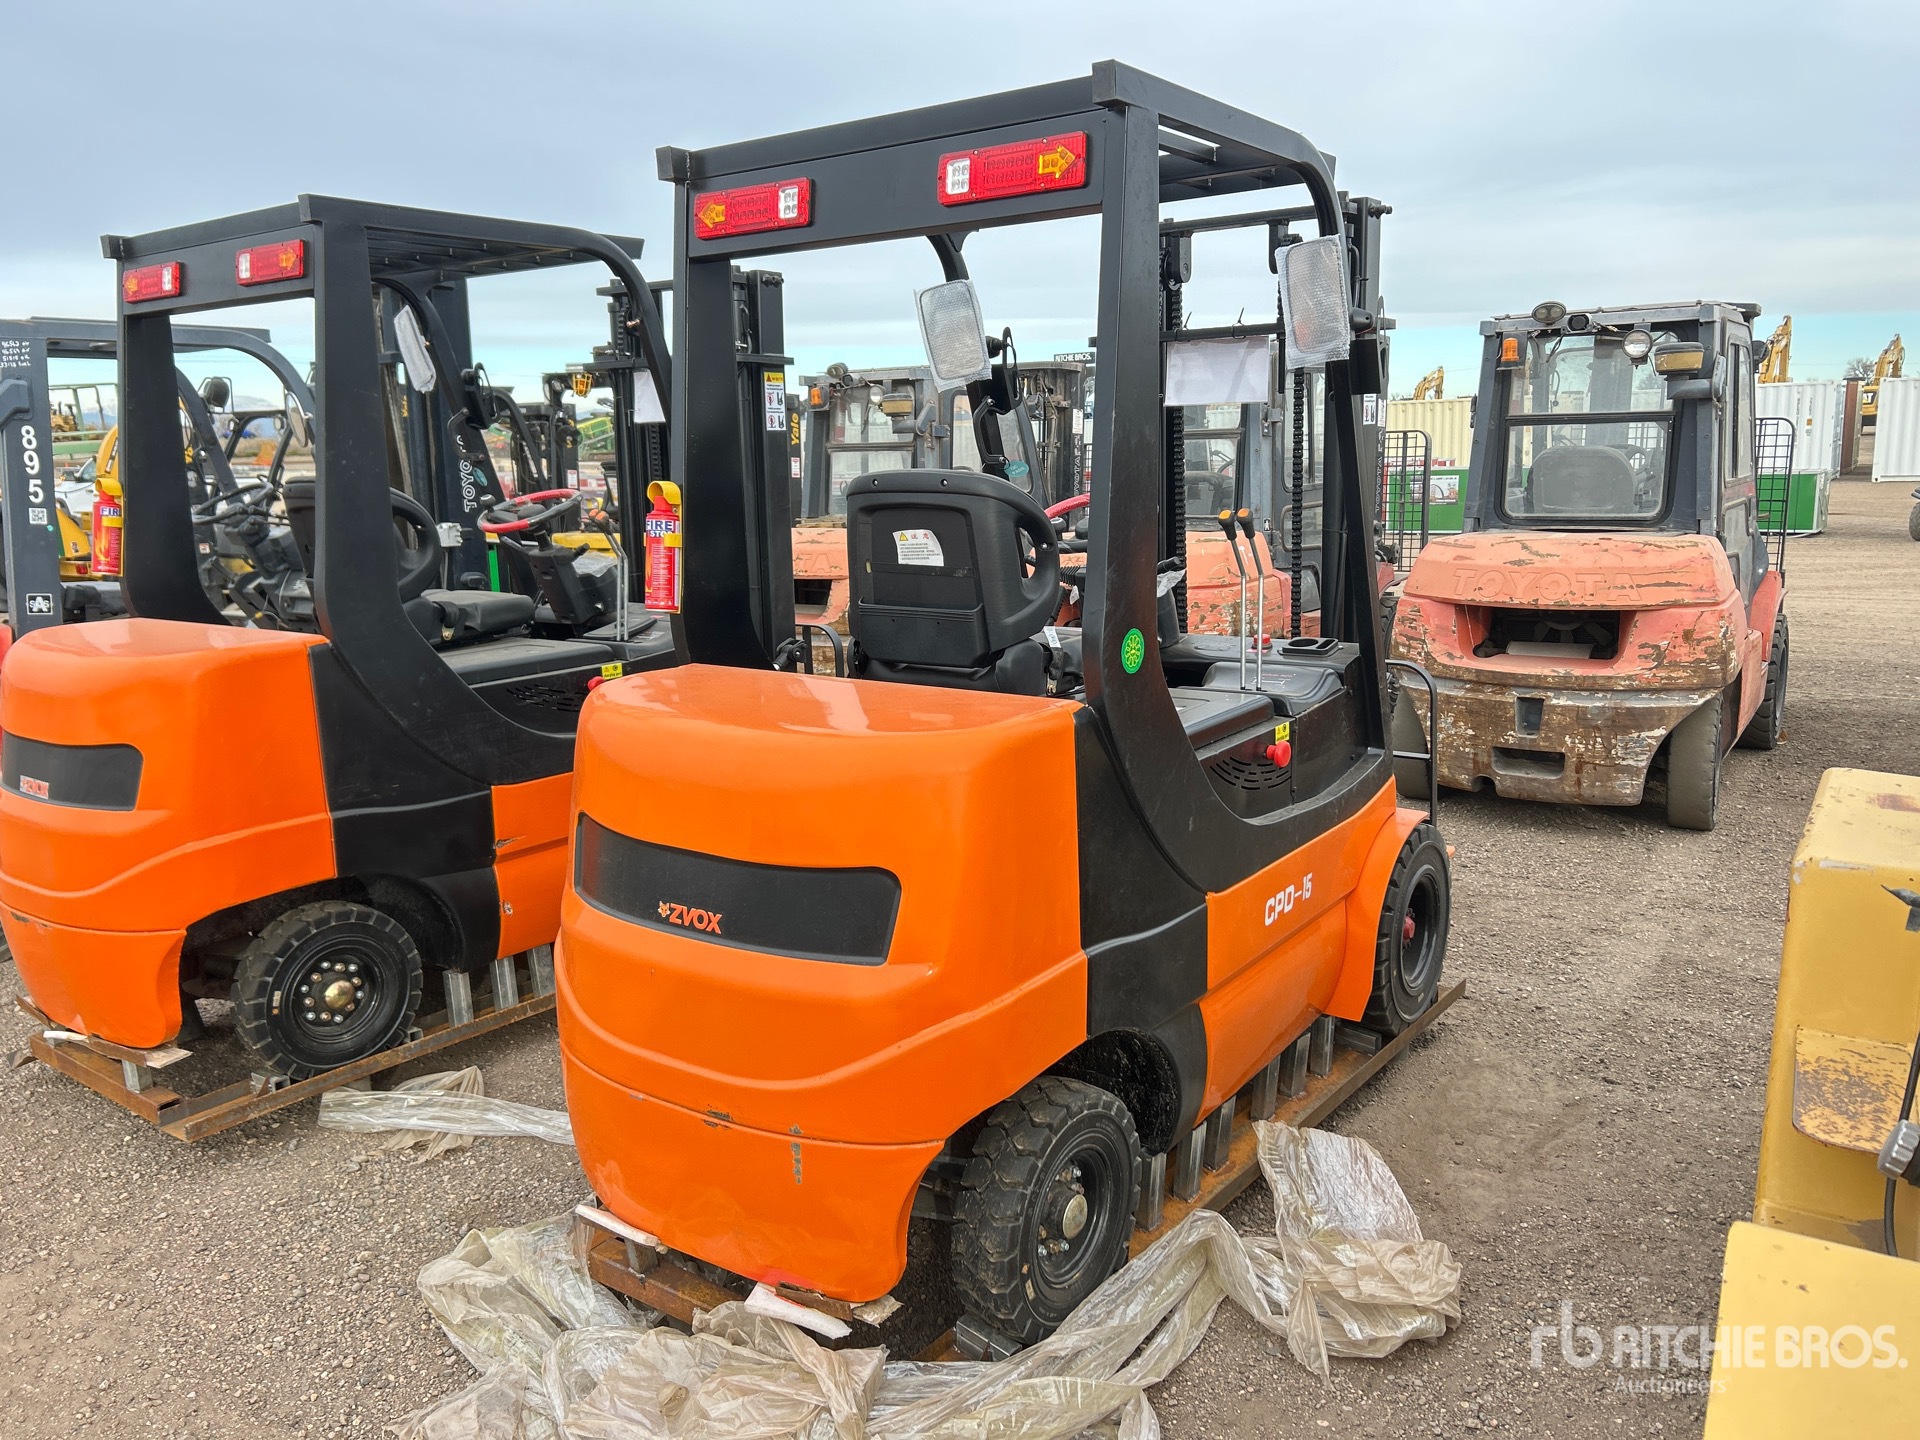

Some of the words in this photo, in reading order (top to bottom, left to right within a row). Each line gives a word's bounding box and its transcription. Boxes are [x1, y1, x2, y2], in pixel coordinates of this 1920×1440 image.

[1055, 354, 1074, 362] RITCHIE
[1075, 353, 1092, 361] BROS.
[1863, 393, 1874, 404] AT
[101, 507, 119, 515] FIR
[645, 520, 673, 531] FIRE
[1452, 568, 1643, 602] TOYOTA
[1264, 872, 1313, 927] CPD-15
[669, 902, 723, 934] ZVOX
